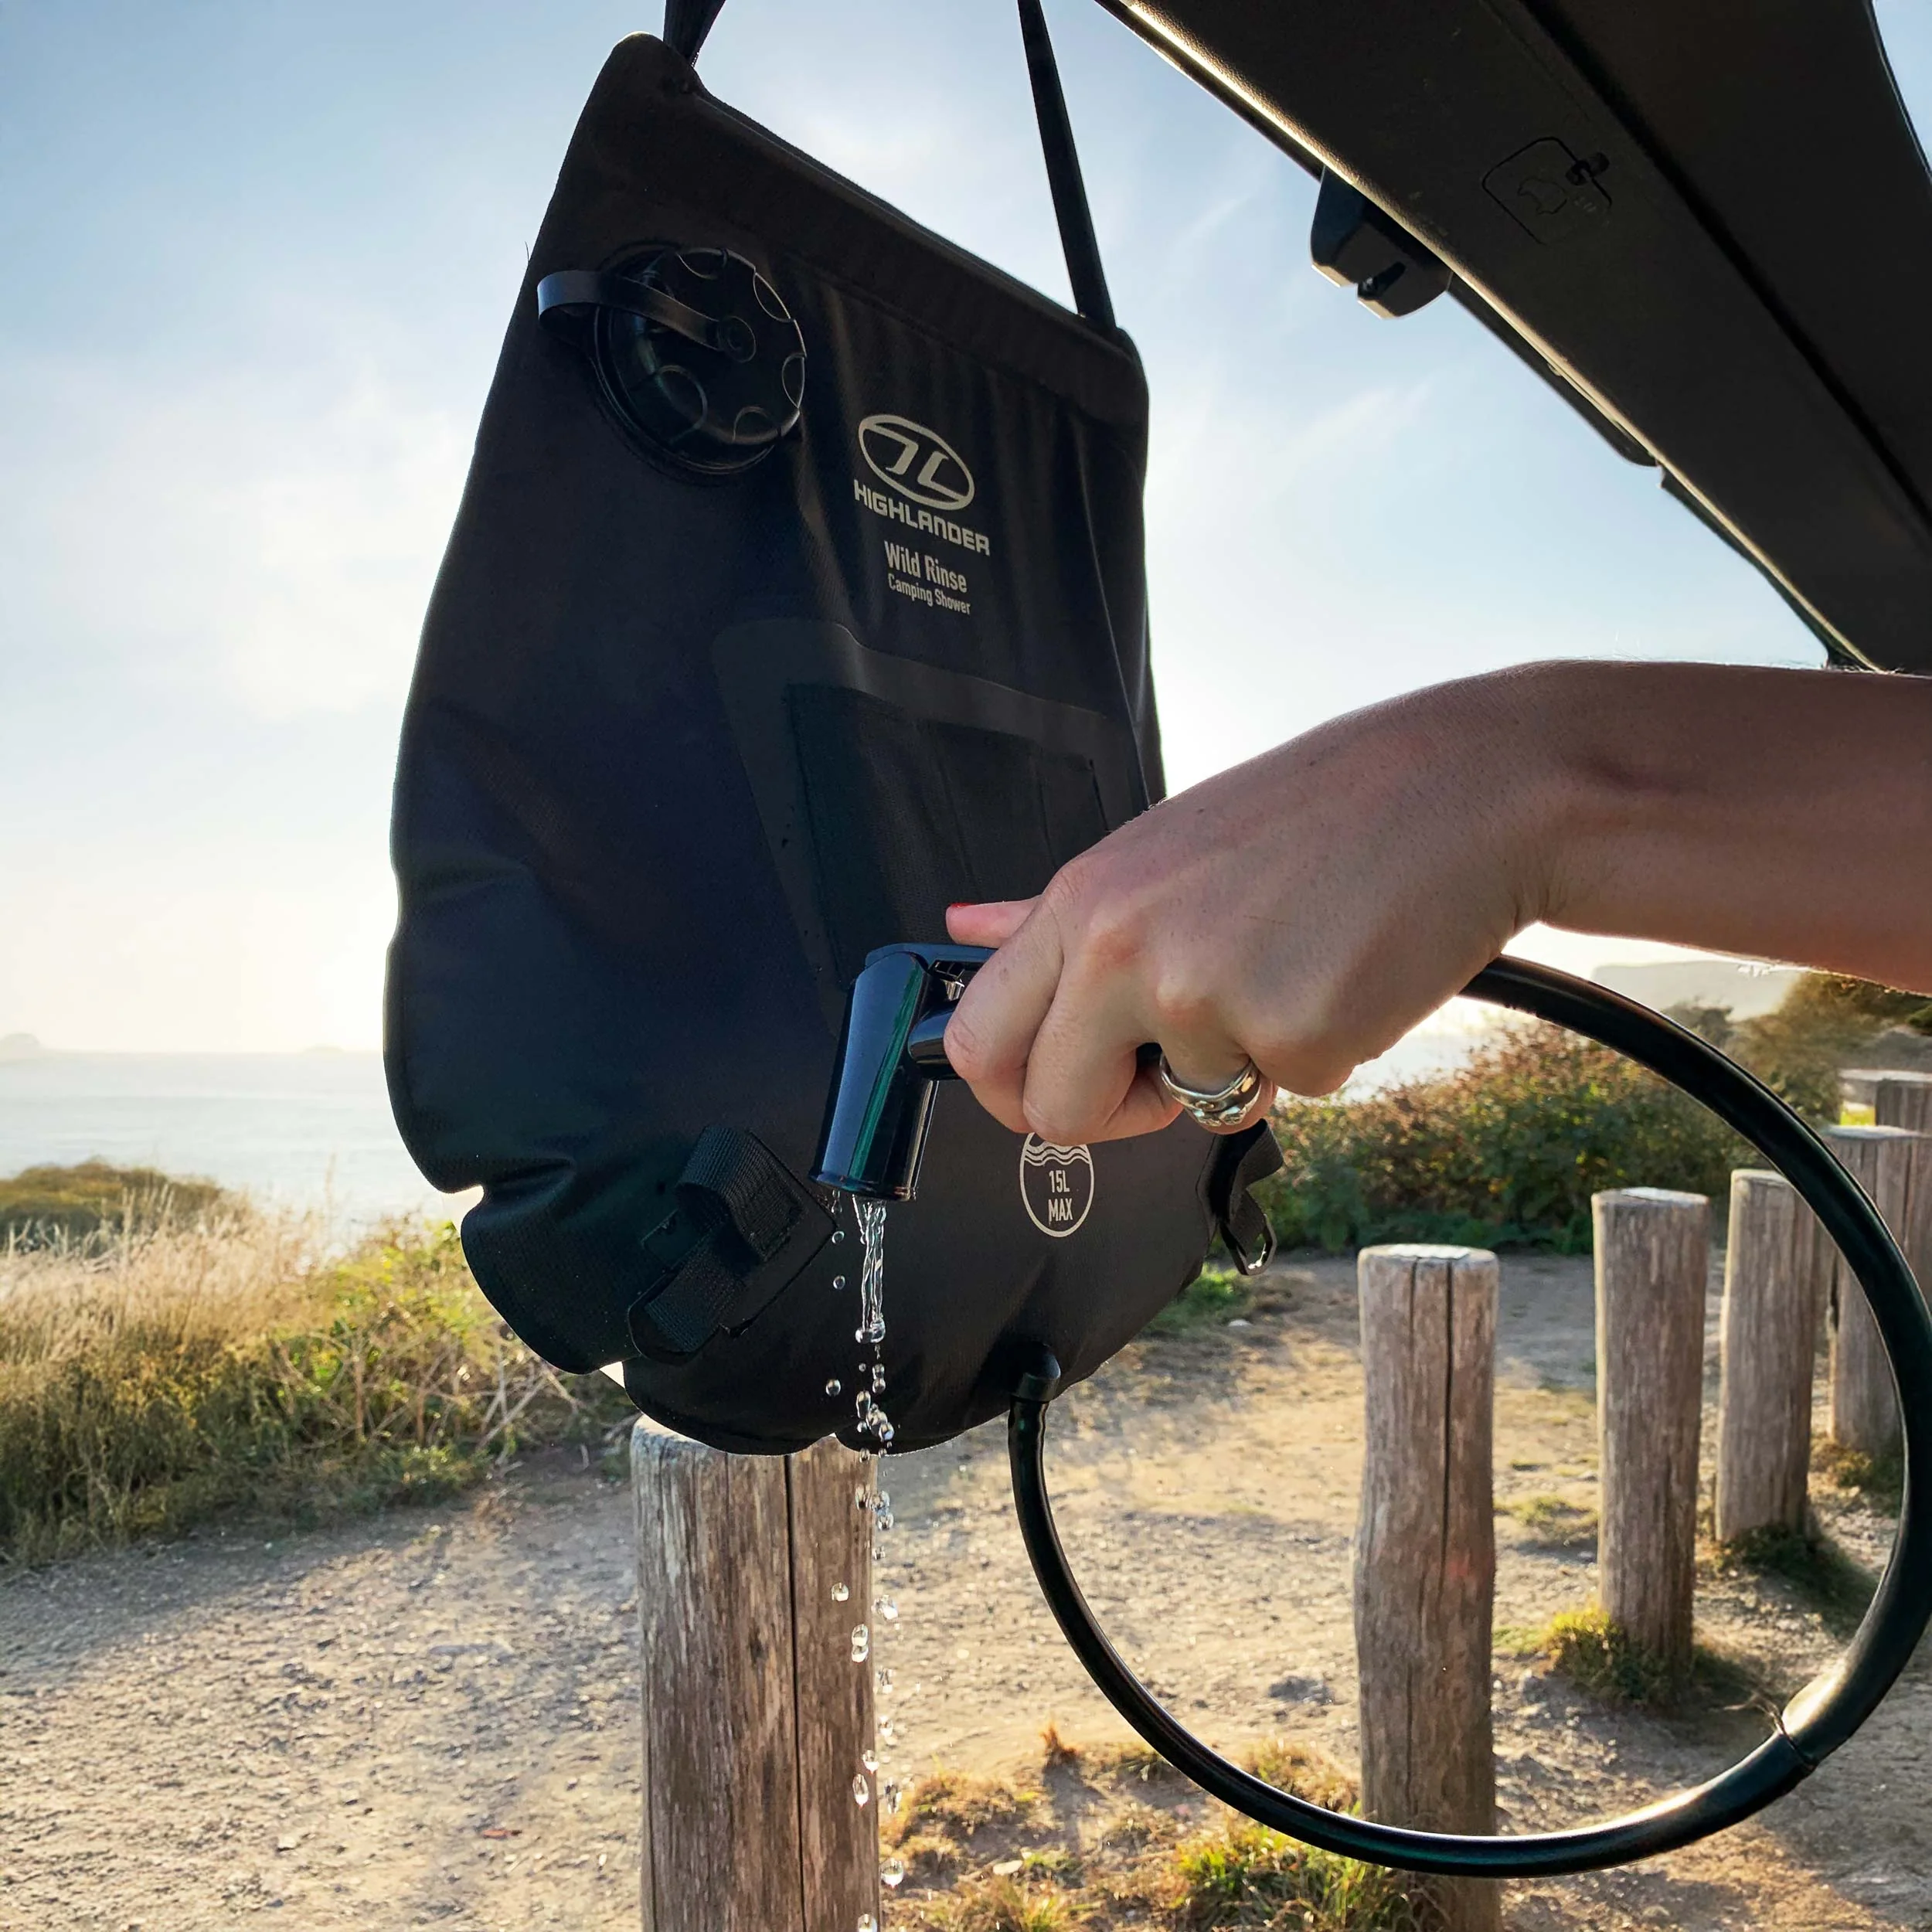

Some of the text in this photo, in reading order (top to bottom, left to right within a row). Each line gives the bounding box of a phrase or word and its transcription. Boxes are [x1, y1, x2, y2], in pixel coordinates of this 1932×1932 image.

[854, 479, 990, 556] HIGHLANDER
[884, 540, 968, 593] Wild Rinse
[888, 573, 971, 615] Camping Shower
[1049, 1169, 1070, 1192] 15L
[1048, 1198, 1073, 1222] MAX
